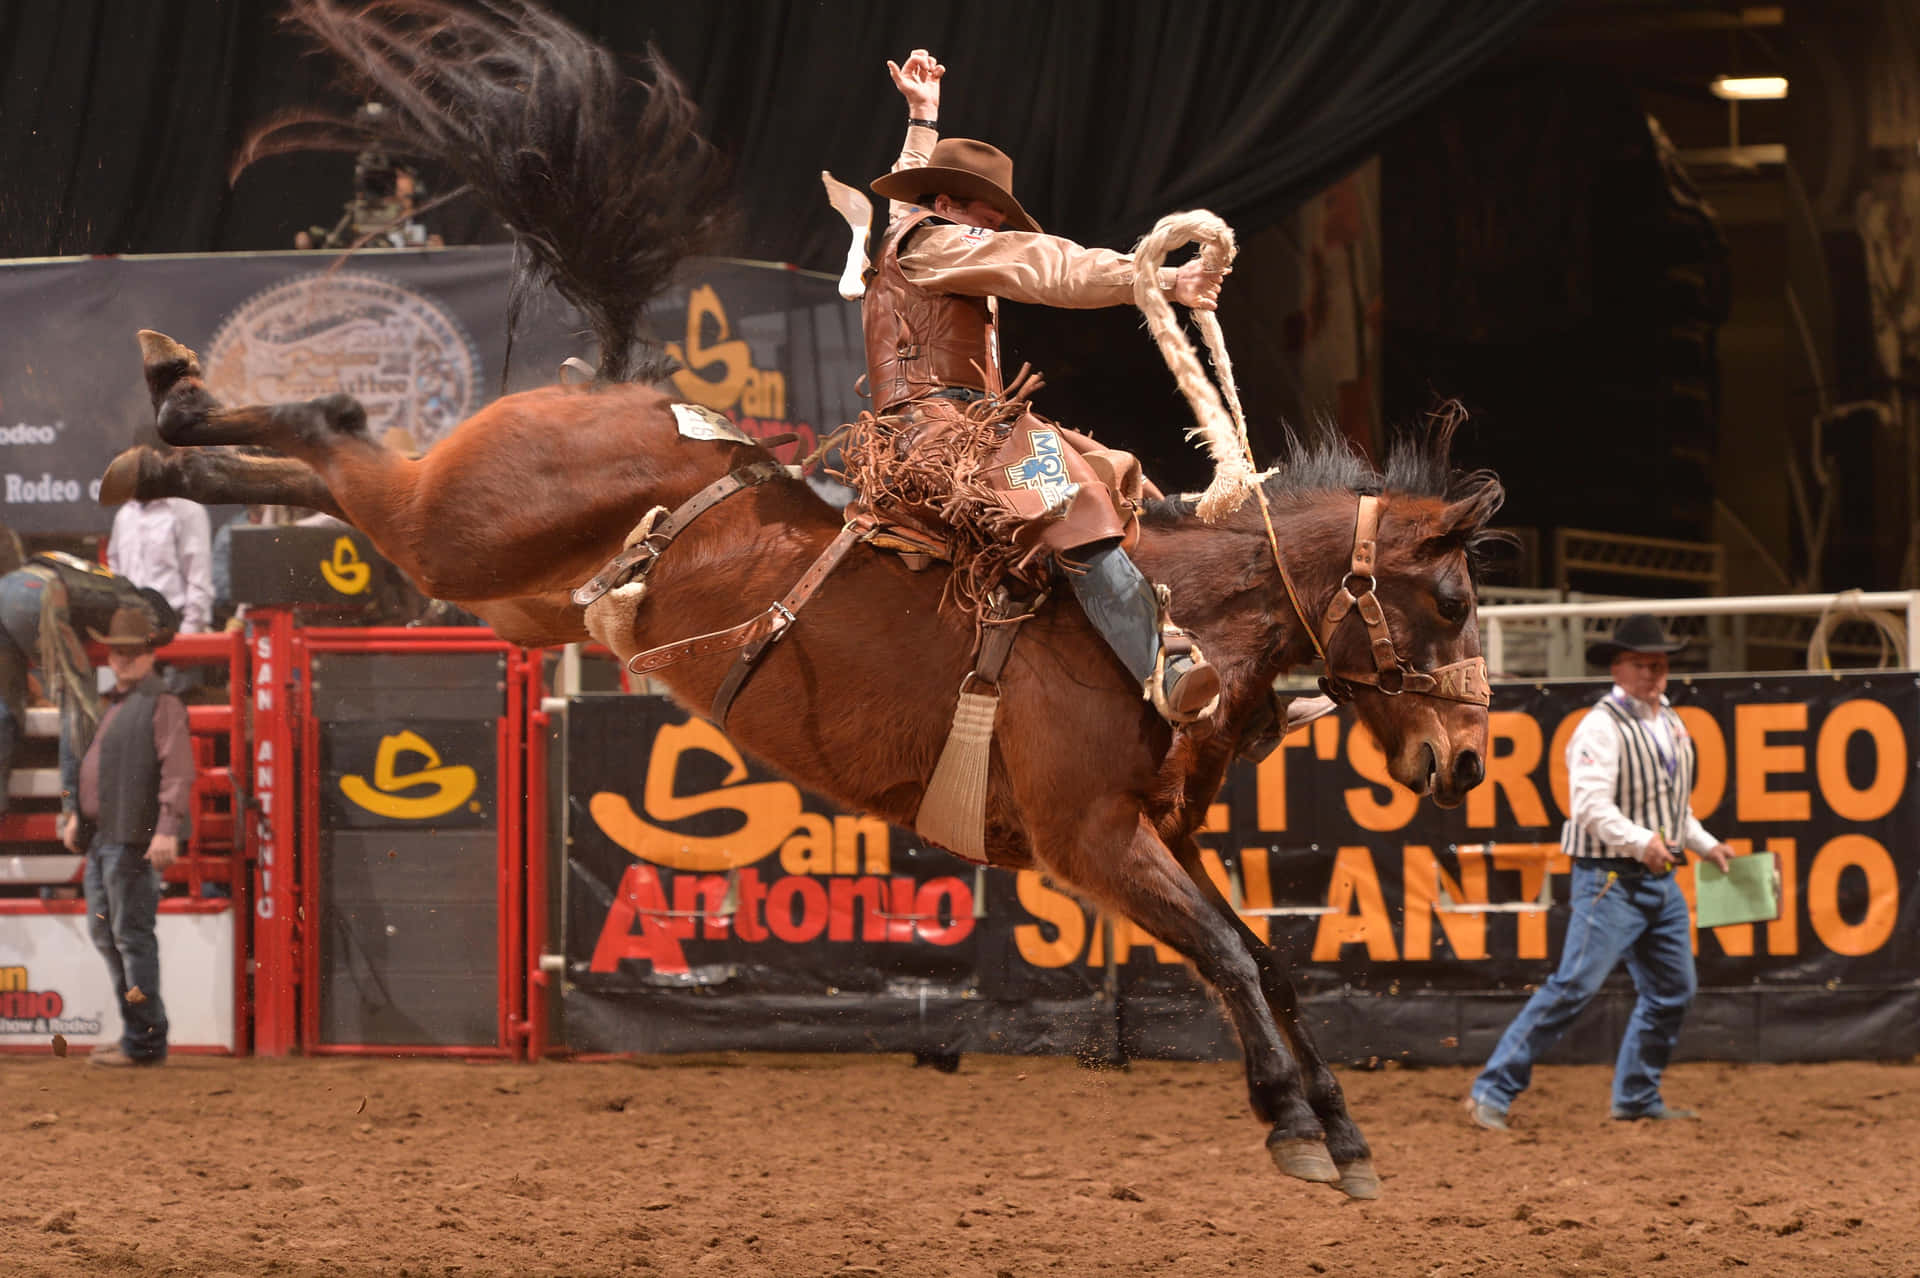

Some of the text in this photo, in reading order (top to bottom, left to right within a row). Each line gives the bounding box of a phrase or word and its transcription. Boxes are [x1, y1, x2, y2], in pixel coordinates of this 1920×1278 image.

[0, 422, 55, 445] odeo
[5, 473, 80, 503] Rodeo
[256, 636, 273, 711] SAN
[591, 717, 890, 876] San
[590, 864, 976, 974] Antonio
[49, 1018, 101, 1034] Rodeo
